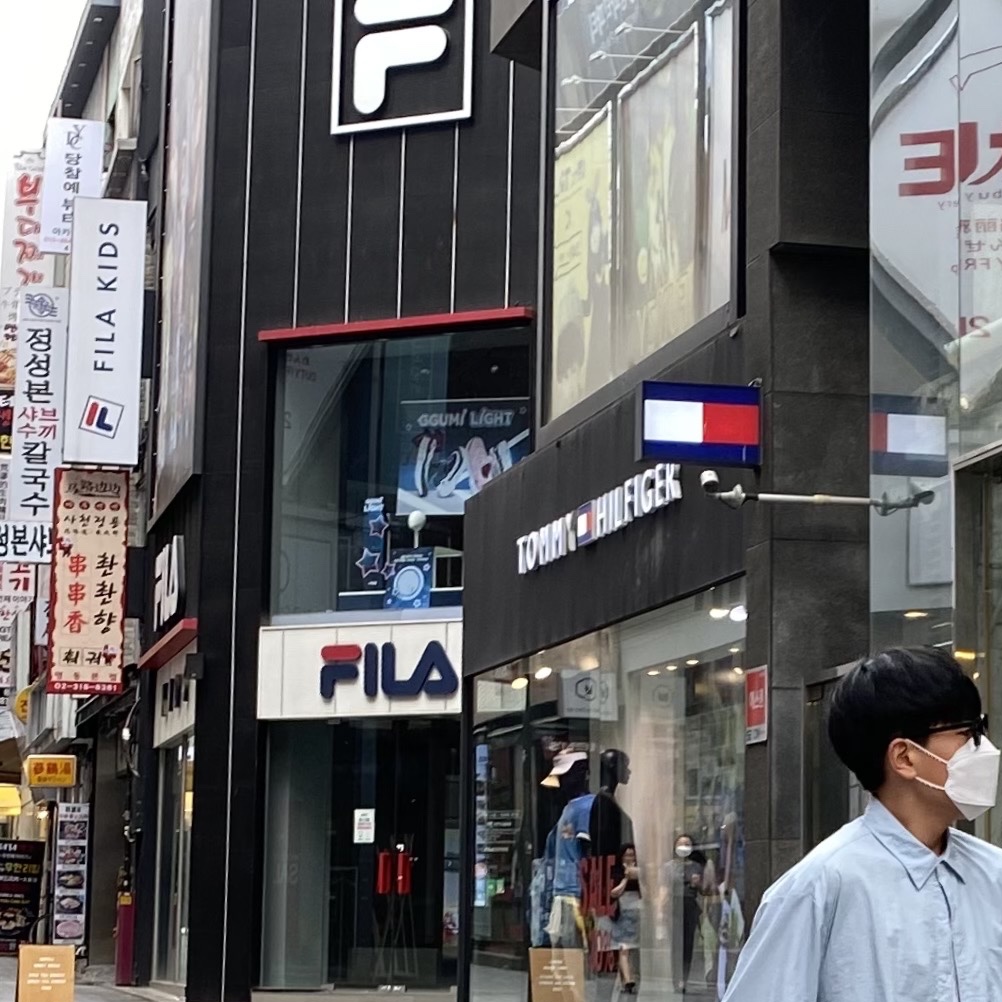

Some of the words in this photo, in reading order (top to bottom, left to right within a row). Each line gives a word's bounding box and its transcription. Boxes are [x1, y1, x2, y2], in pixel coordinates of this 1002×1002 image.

[97, 222, 119, 292] KIDS
[22, 327, 54, 404] 정성본
[94, 309, 116, 372] FILA
[17, 406, 59, 422] 샤브
[20, 441, 52, 517] 칼국수
[516, 513, 577, 575] TOMMY
[595, 463, 682, 538] HILFIGER
[63, 554, 88, 634] 串串香
[320, 640, 459, 700] FILA
